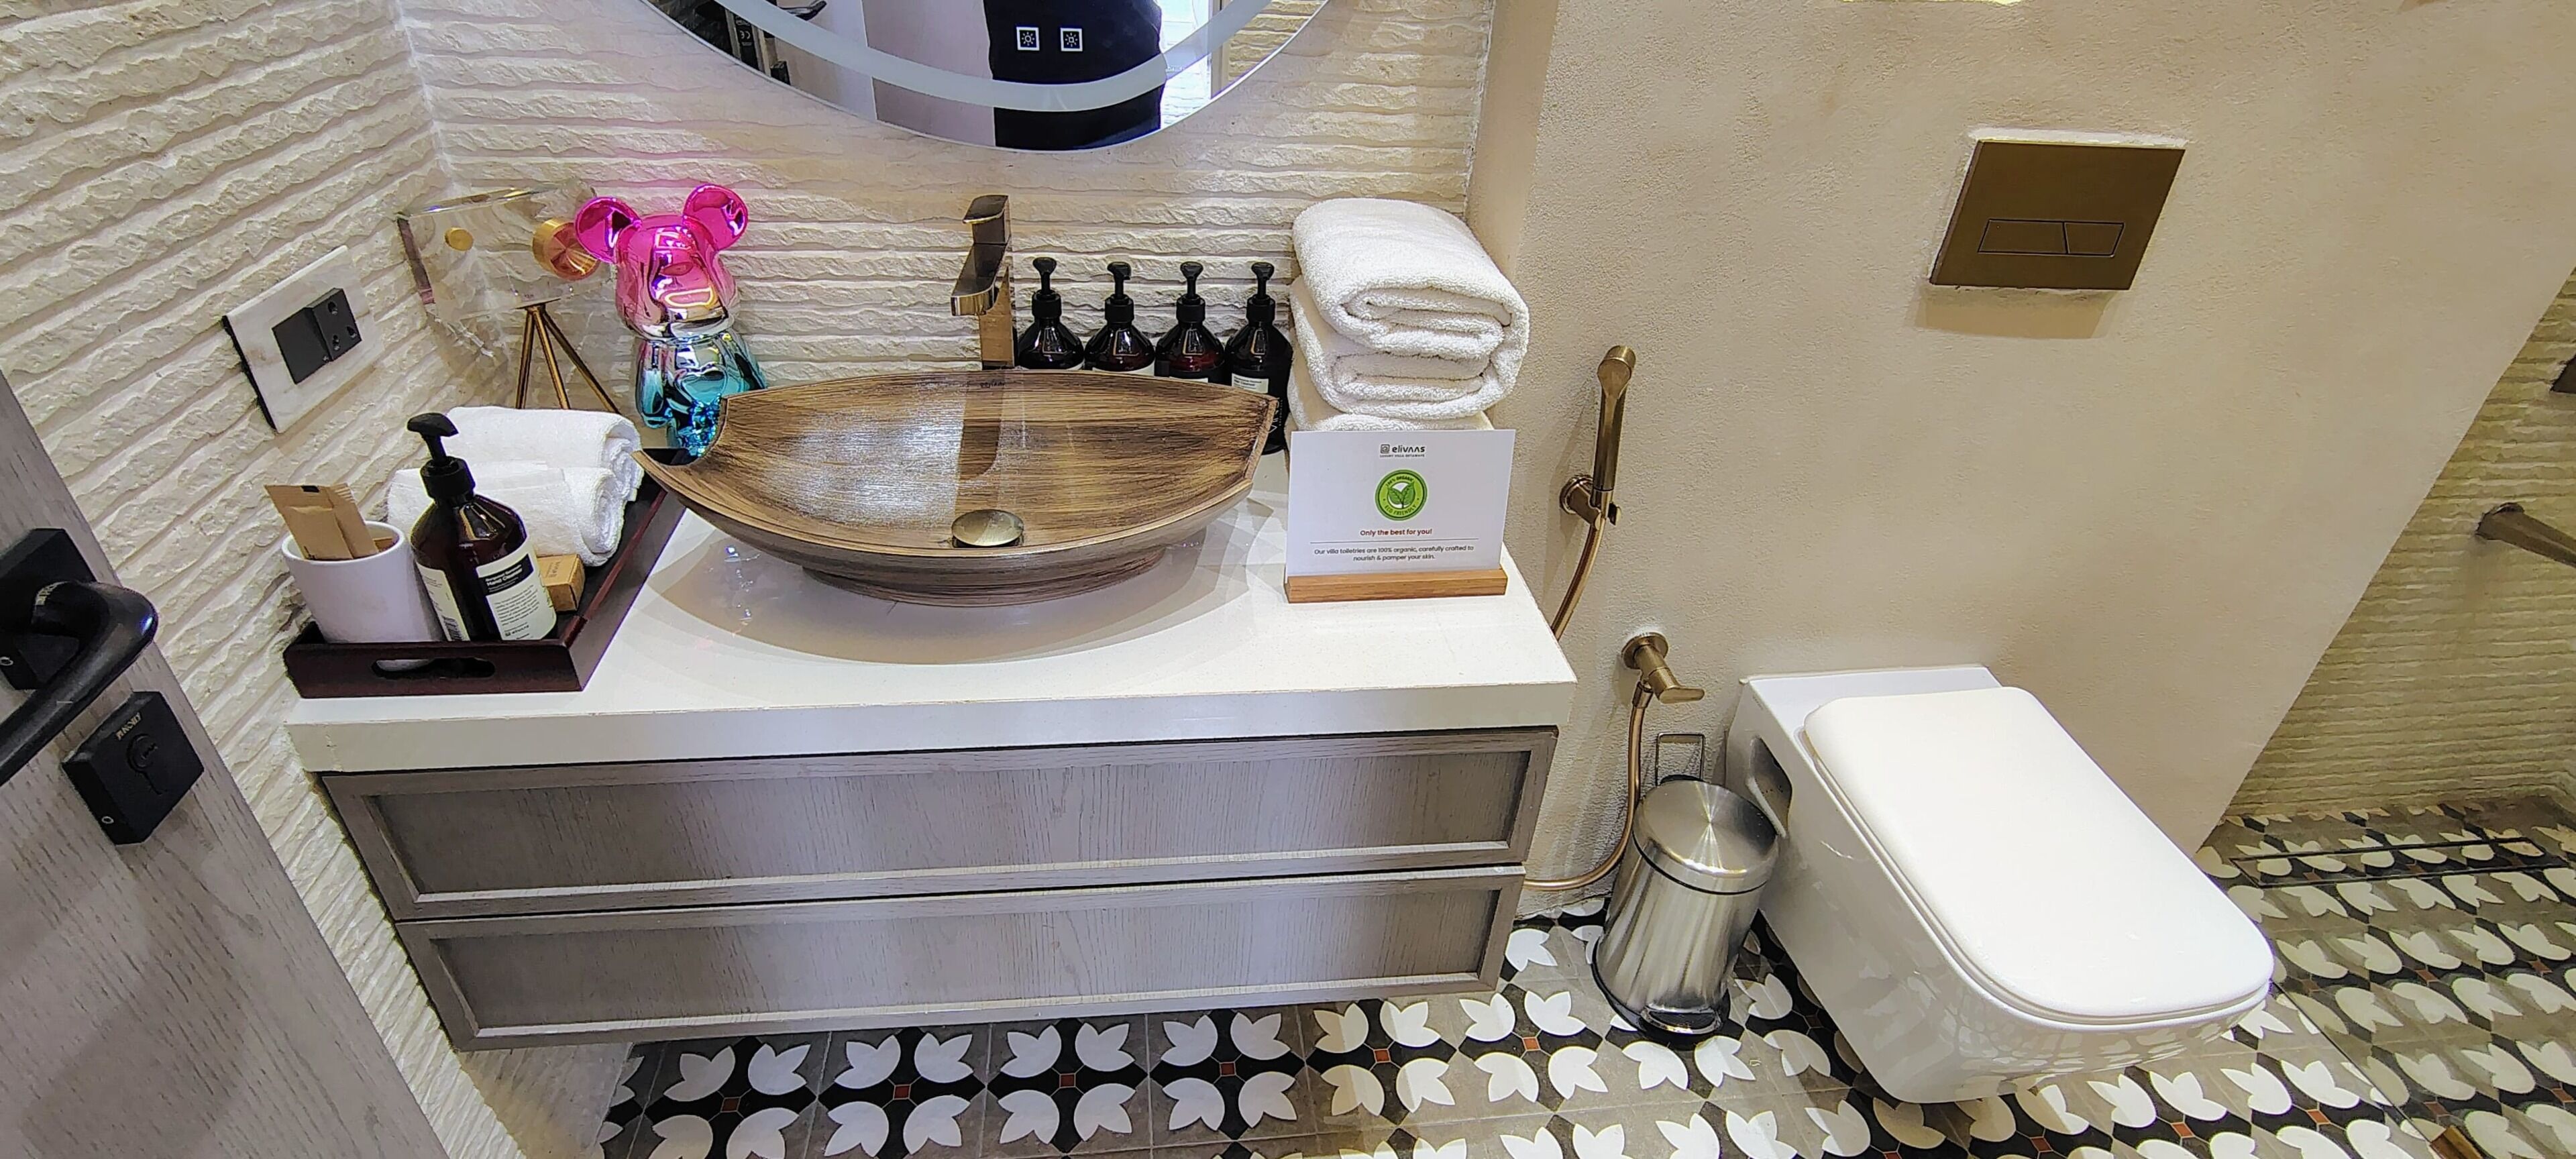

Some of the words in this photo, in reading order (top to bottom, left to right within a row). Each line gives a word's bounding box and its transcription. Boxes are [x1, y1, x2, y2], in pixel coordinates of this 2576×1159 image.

[1384, 504, 1393, 514] ECO
[1417, 529, 1433, 537] you!
[486, 578, 502, 586] Hand
